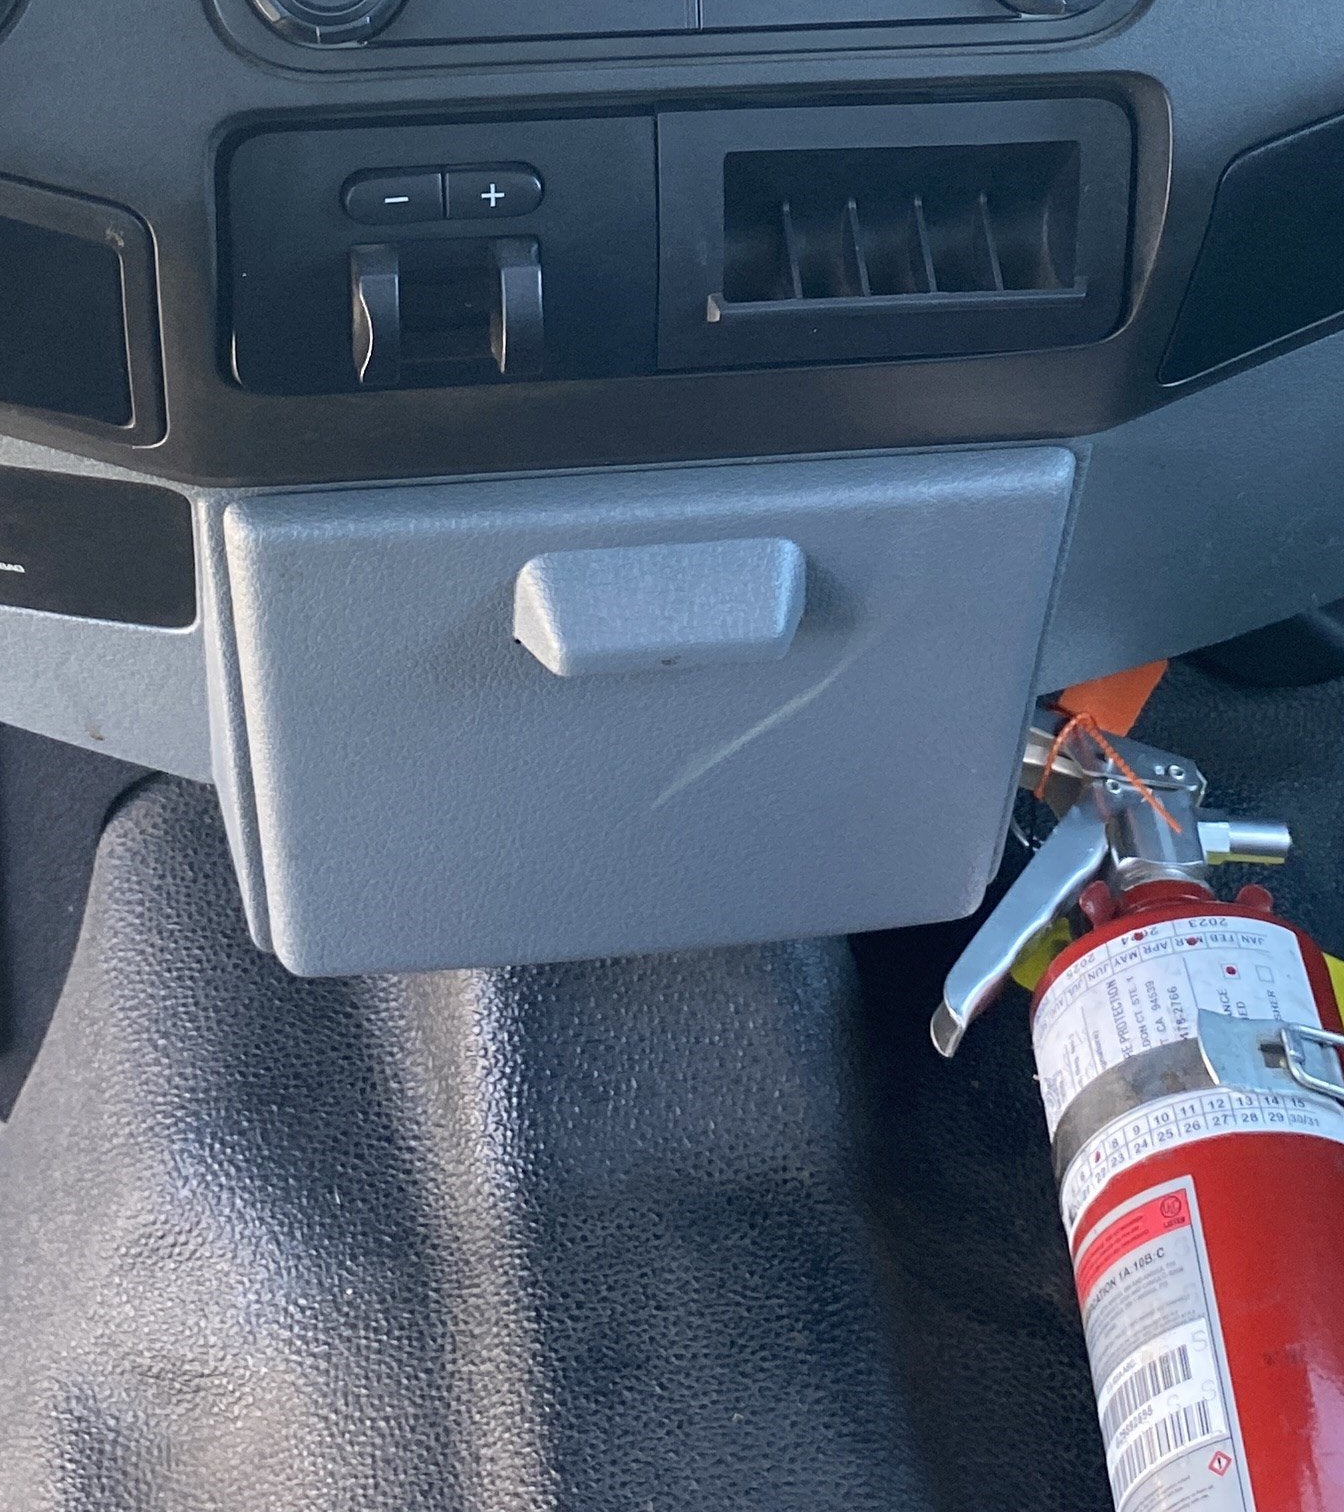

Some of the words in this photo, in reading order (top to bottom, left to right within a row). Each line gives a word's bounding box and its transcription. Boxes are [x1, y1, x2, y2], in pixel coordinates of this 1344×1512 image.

[1188, 917, 1228, 929] 2023
[1241, 934, 1265, 945] JAN
[1143, 941, 1168, 955] APR
[1113, 949, 1139, 967] MAY
[1153, 1112, 1170, 1125] 10
[1180, 1105, 1197, 1116] 11
[1207, 1098, 1225, 1110] 12
[1235, 1095, 1254, 1107] 13
[1264, 1094, 1280, 1106] 14
[1291, 1097, 1306, 1108] 15
[1110, 1153, 1126, 1168] 23
[1134, 1139, 1149, 1155] 24
[1157, 1128, 1174, 1143] 25
[1183, 1120, 1202, 1134] 26
[1212, 1113, 1229, 1127] 27
[1241, 1112, 1258, 1124] 28
[1268, 1112, 1285, 1123] 29
